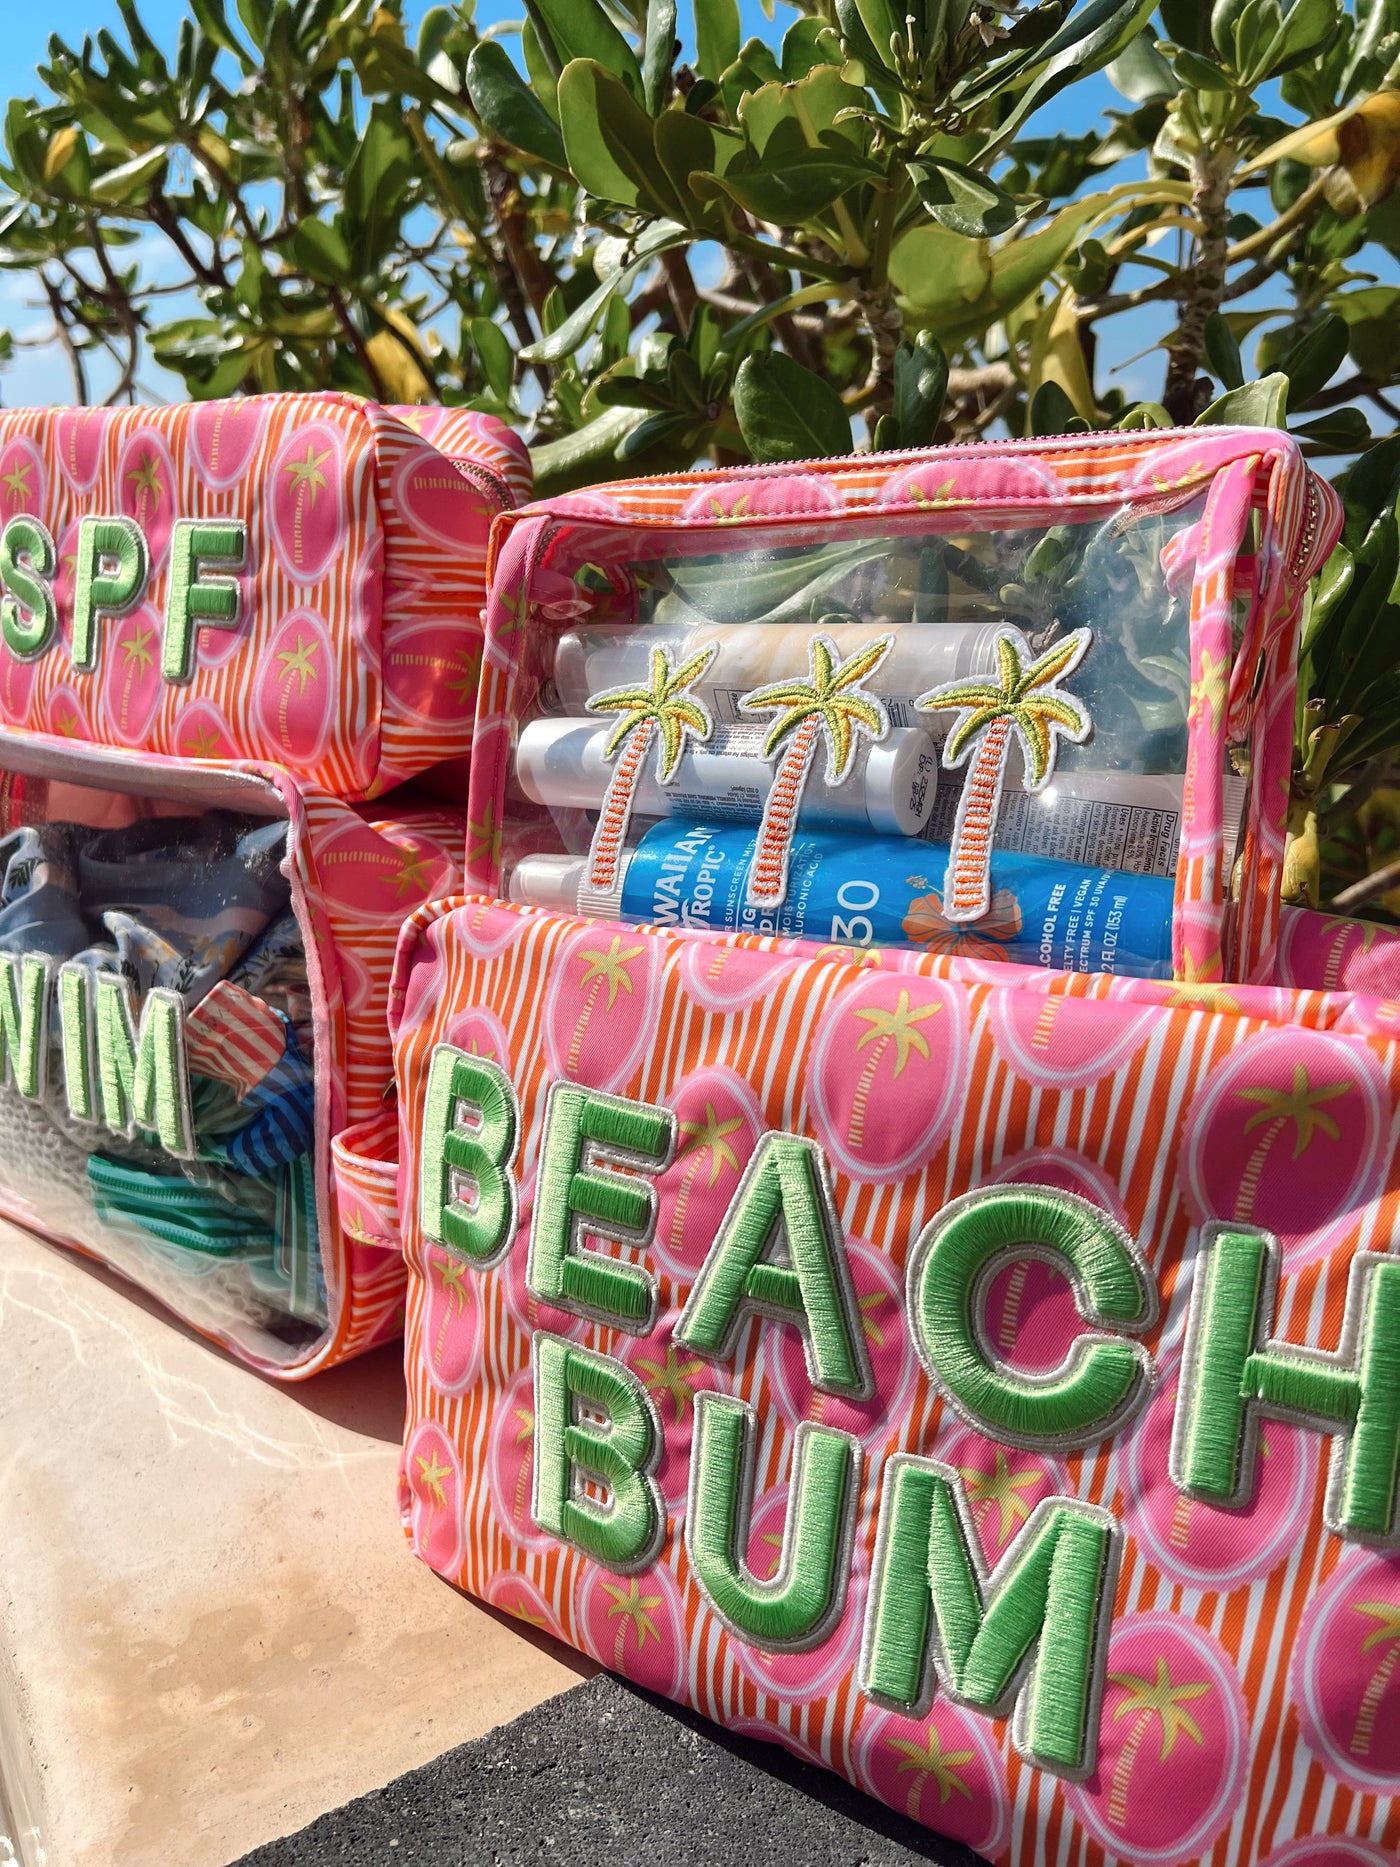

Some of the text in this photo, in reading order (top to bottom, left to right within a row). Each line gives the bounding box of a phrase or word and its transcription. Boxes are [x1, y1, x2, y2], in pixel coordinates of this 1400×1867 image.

[0, 513, 247, 686] SPF
[1015, 793, 1028, 827] Directions
[1119, 807, 1127, 825] Uses
[807, 852, 823, 877] ACID
[1142, 812, 1160, 872] Active Ingredients
[1157, 814, 1173, 867] Drug Facts
[725, 858, 747, 922] SUNSCREEN
[782, 843, 817, 937] MOISTURIZATION
[831, 880, 880, 946] 30
[1047, 884, 1067, 912] FREE
[1066, 915, 1080, 942] FREE
[1073, 879, 1092, 907] VEGAN
[1090, 896, 1100, 907] 30
[1085, 908, 1097, 927] SPF
[1104, 931, 1118, 947] OZ
[1105, 911, 1122, 930] (153
[421, 1043, 1400, 1542] BEACH
[531, 1331, 1127, 1781] BUM
